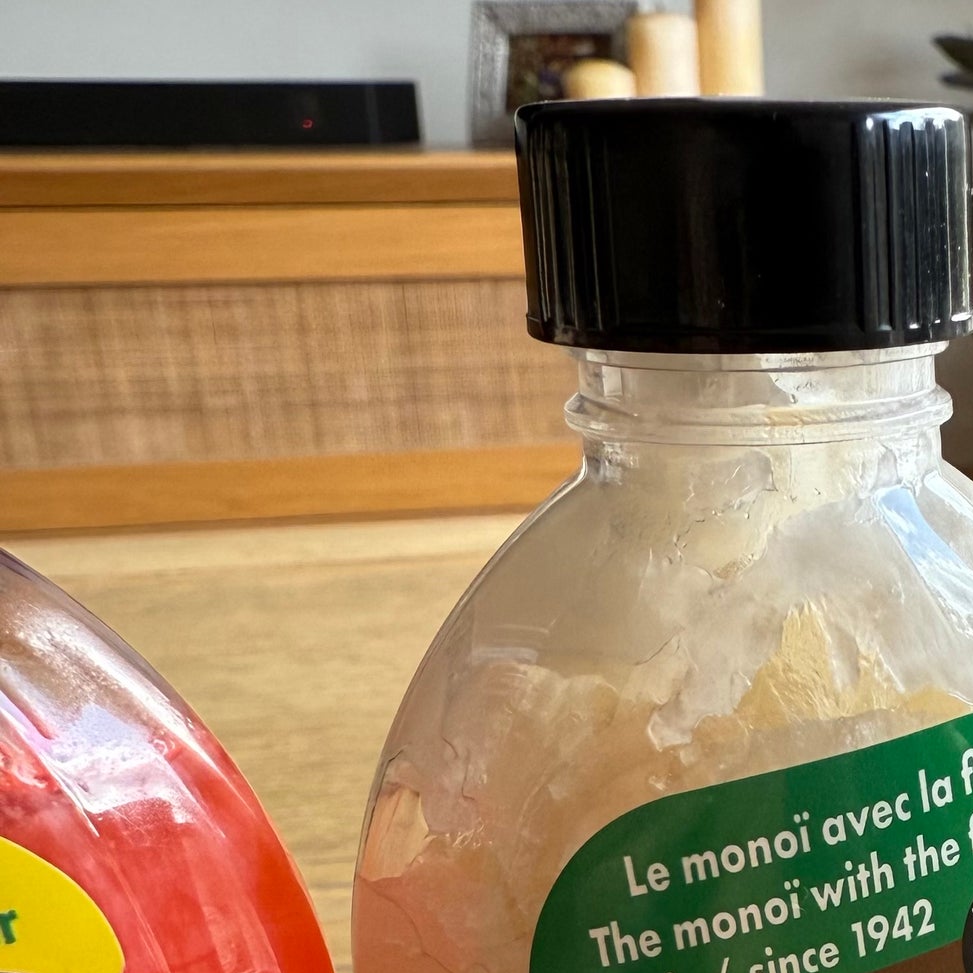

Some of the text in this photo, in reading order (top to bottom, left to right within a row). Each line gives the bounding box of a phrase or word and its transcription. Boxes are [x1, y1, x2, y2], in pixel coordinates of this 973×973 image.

[623, 855, 671, 897] Le
[681, 810, 812, 884] monoï
[822, 793, 912, 846] avec
[918, 769, 954, 813] la
[589, 920, 662, 967] The
[673, 878, 802, 950] monoï
[810, 851, 895, 912] with
[903, 834, 961, 882] the
[851, 898, 935, 958] 1942
